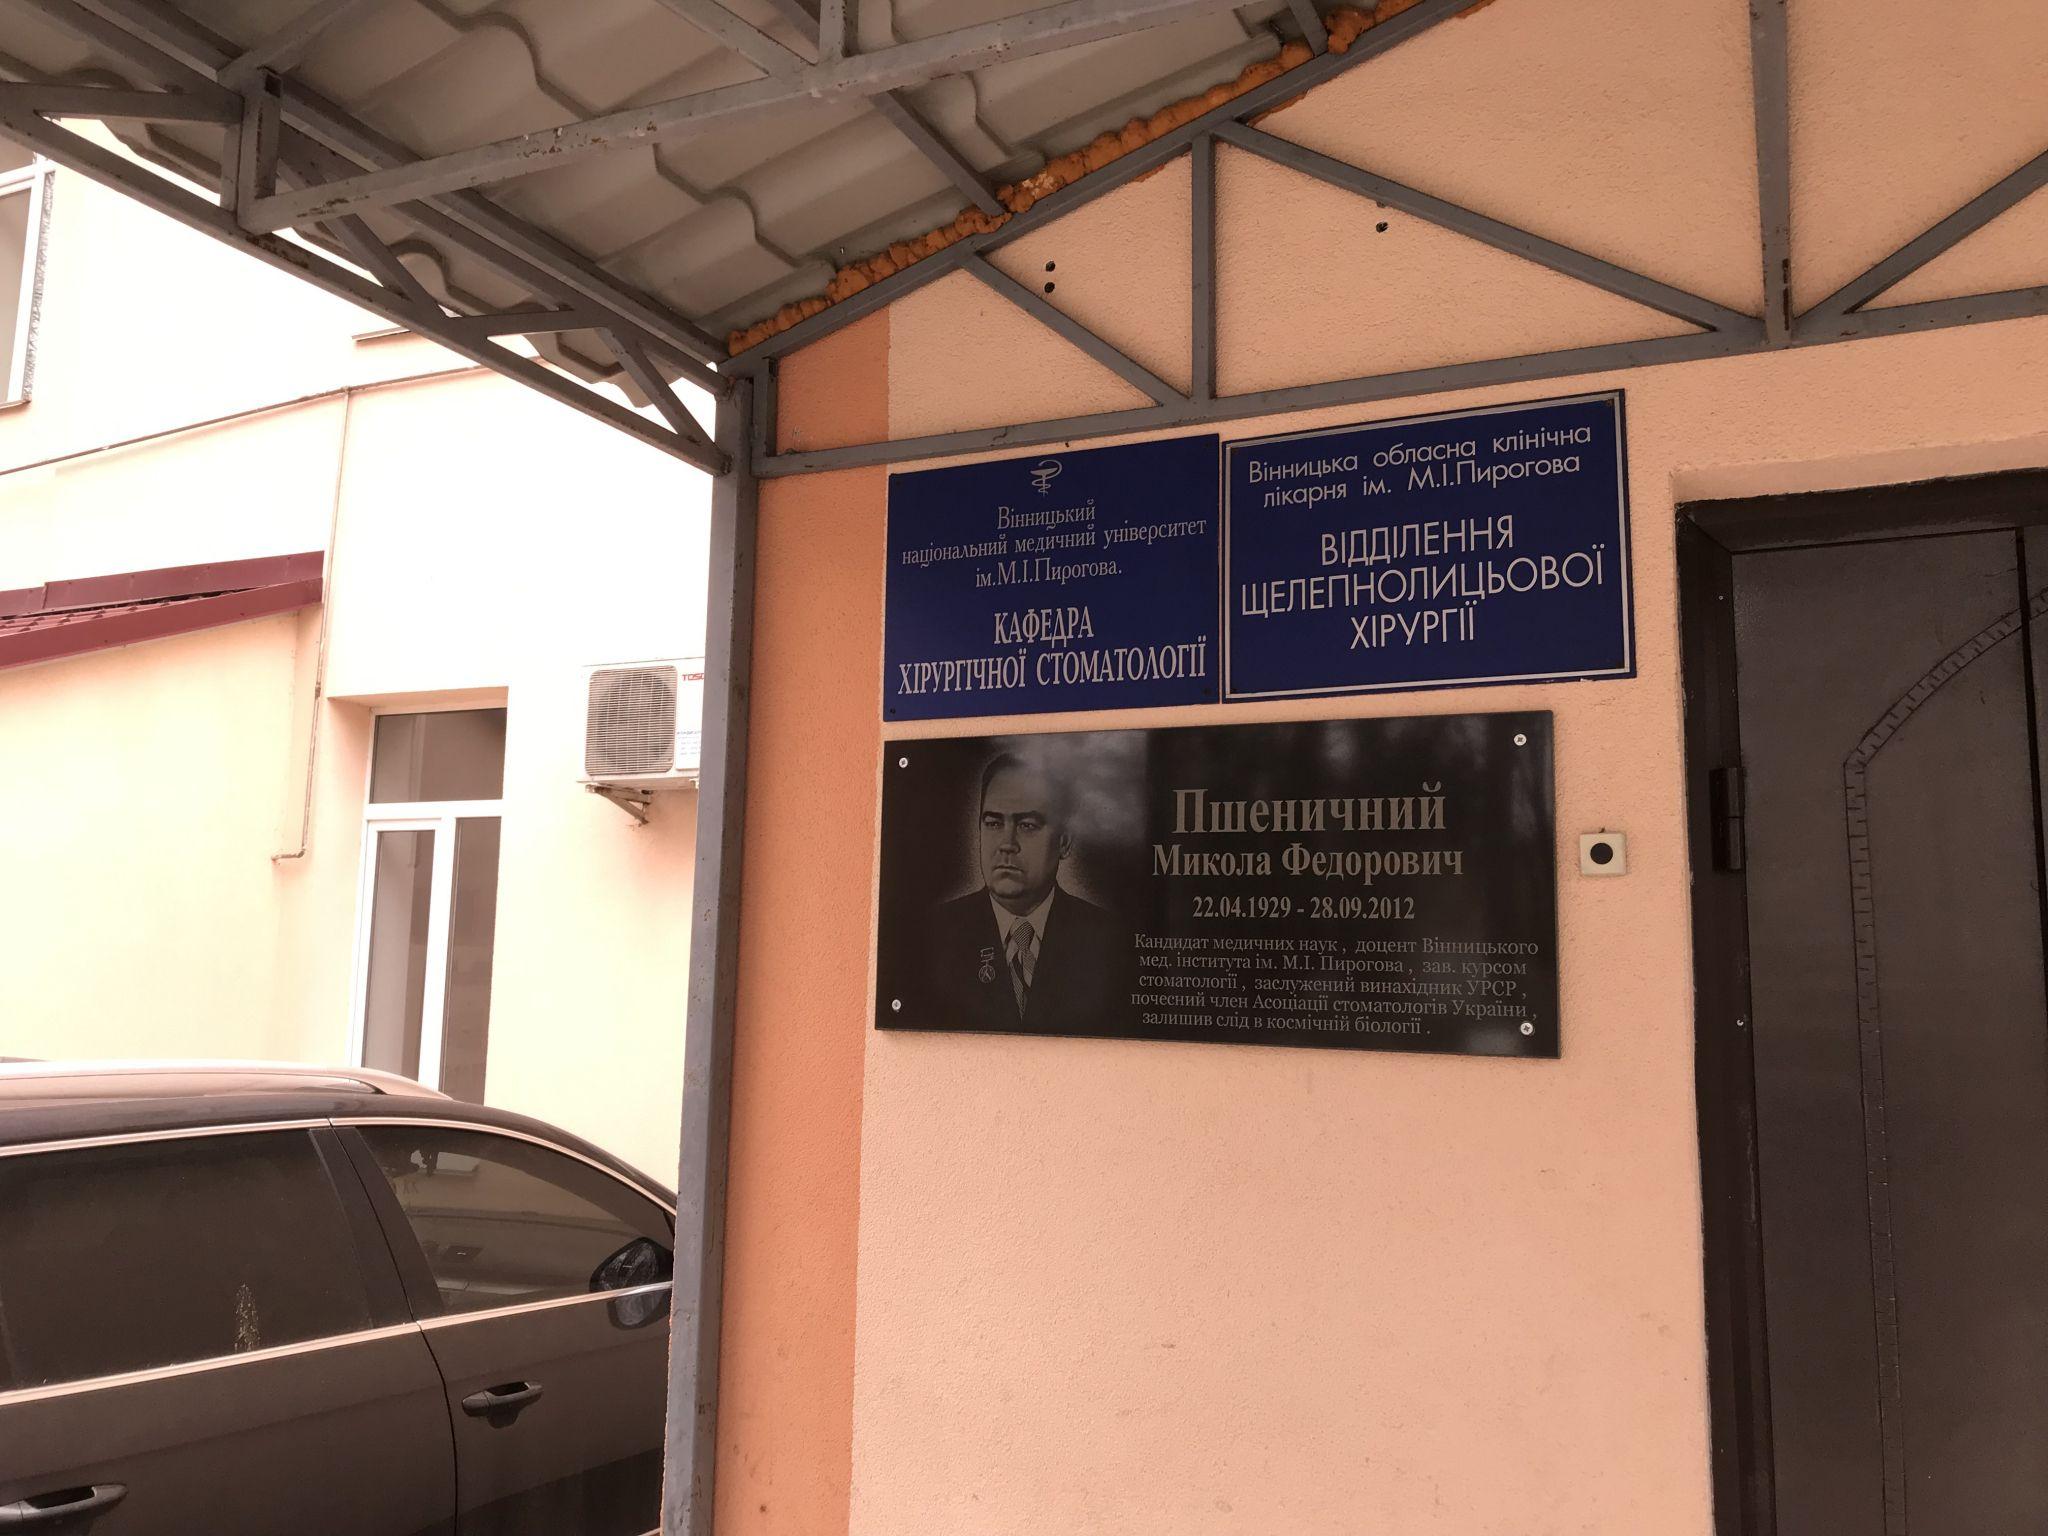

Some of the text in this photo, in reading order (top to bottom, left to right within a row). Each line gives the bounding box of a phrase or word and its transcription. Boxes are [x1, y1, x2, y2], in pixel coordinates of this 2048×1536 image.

[1249, 426, 1591, 483] Вінницька обласна клінічна
[1264, 454, 1580, 508] лікарня ім. М.І.Пирогова
[998, 499, 1096, 530] Вінницький
[902, 520, 1207, 568] національний медичний університет
[1321, 515, 1514, 567] ВІДДІЛЕННЯ
[1242, 543, 1605, 618] ЩЕЛЕПНОЛИЦЬОВОЇ
[994, 606, 1094, 648] КАФЕДРА
[1350, 600, 1478, 650] ХІРУРГІЇ
[898, 635, 1208, 694] ХІРУРГІЧНОЇ СТОМАТОЛОГІЇ
[1172, 781, 1446, 834] Пшеничний
[1152, 843, 1464, 886] Микола Федорович
[1192, 896, 1291, 919] 22.04.1929
[1310, 896, 1416, 920] 28.09.2012
[1135, 934, 1209, 950] Кандидат
[1213, 939, 1294, 951] медичних
[1356, 941, 1416, 954] доцент
[1422, 937, 1538, 956] Вінницького
[1139, 955, 1172, 969] мед.
[1177, 952, 1250, 972] інститута
[1256, 954, 1278, 969] ім.
[1422, 962, 1456, 973] зав.
[1462, 962, 1527, 978] курсом
[1131, 992, 1205, 1006] почесний
[1210, 997, 1248, 1009] член
[1252, 994, 1328, 1012] Асоціації
[1333, 998, 1448, 1015] стоматологів
[1254, 977, 1355, 994] заслужений
[1360, 978, 1462, 996] винахідник
[1142, 1012, 1212, 1026] залишив
[1216, 1012, 1250, 1029] слід
[1254, 1018, 1262, 1028] в
[1267, 1014, 1350, 1033] космічній
